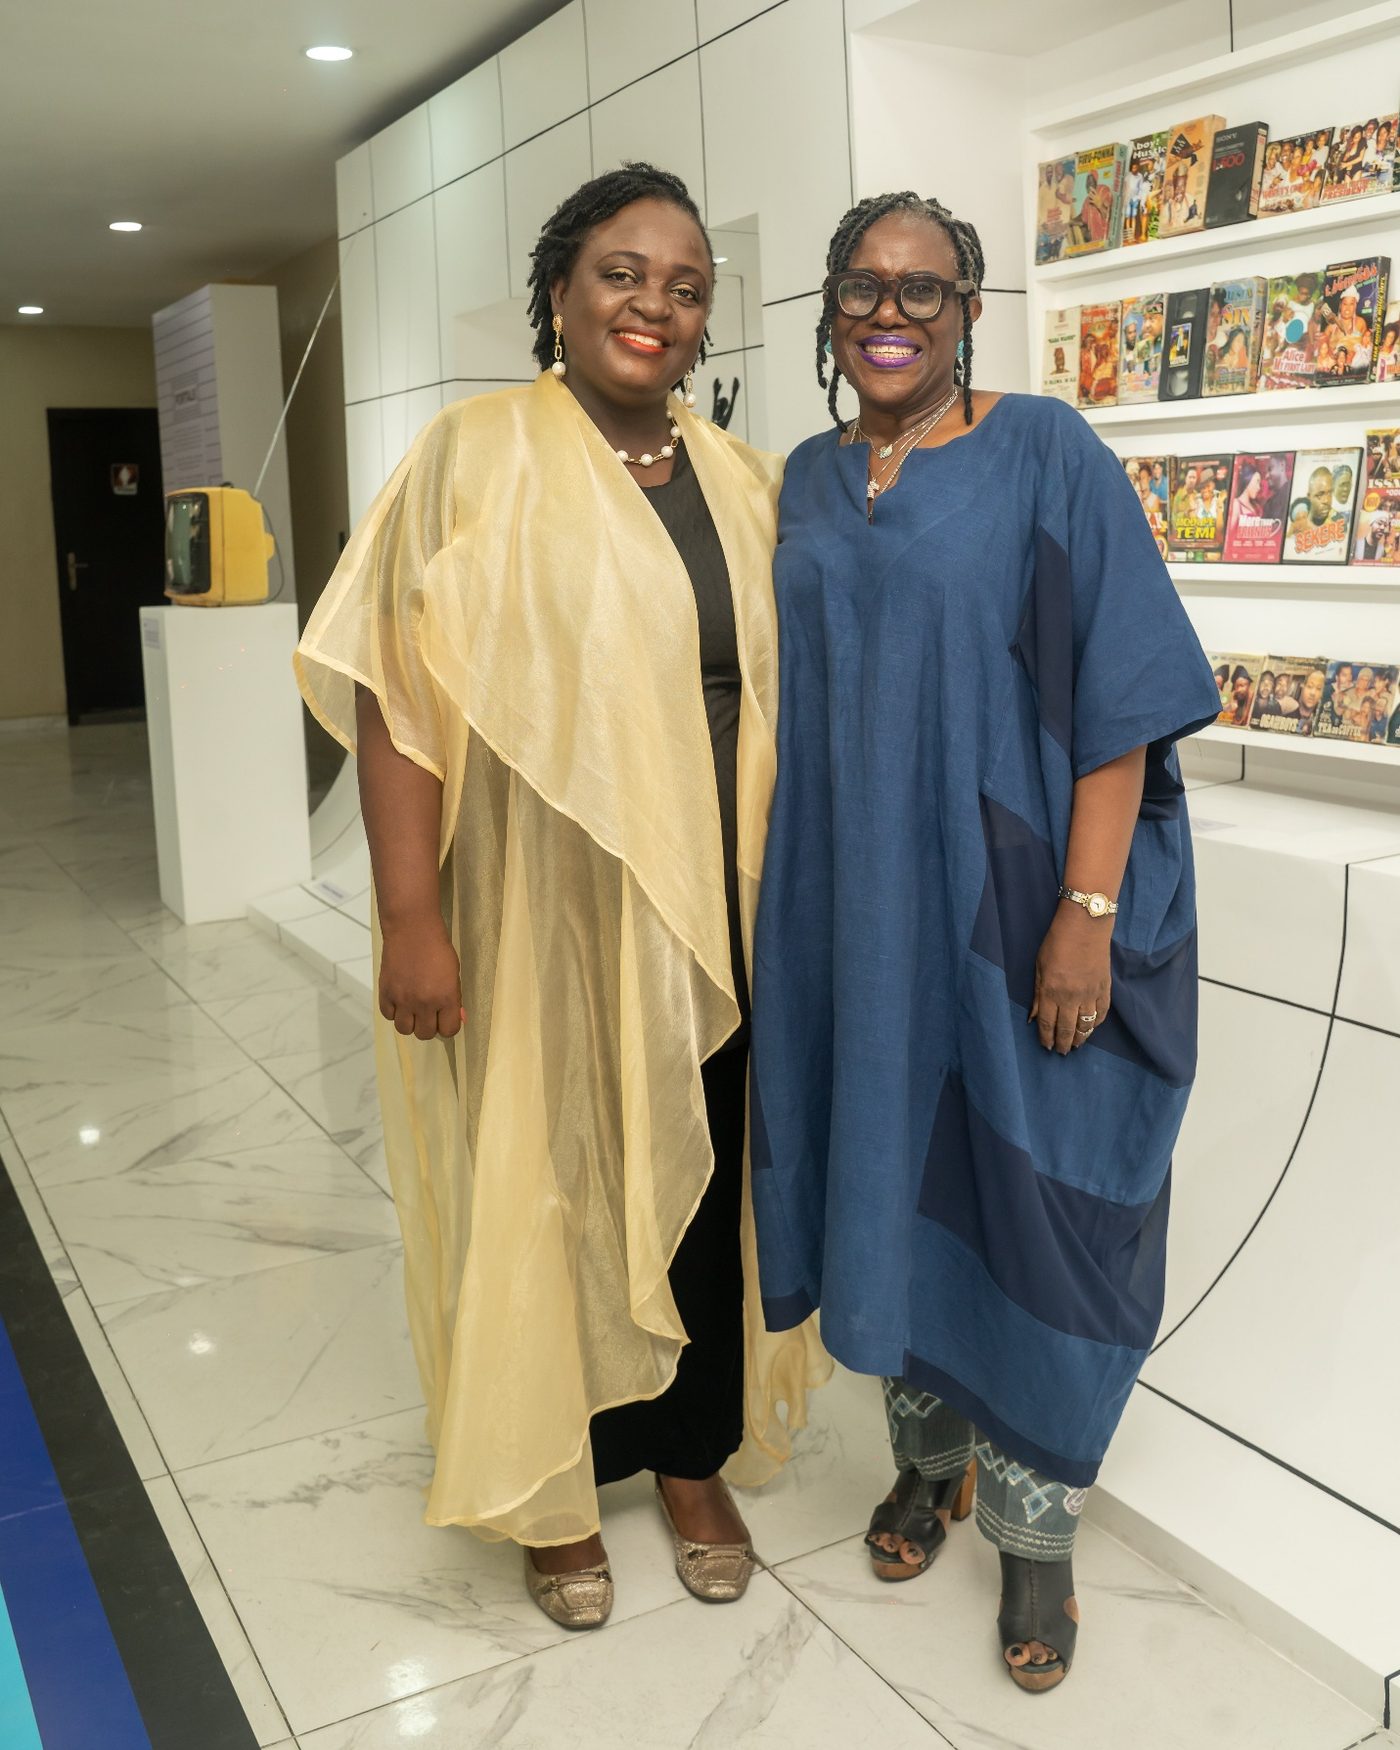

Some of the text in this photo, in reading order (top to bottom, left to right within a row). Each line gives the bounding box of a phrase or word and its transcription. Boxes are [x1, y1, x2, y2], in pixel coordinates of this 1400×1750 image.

[1216, 132, 1238, 143] SONY
[1283, 349, 1305, 362] Alice
[1176, 527, 1216, 539] TEMI
[1295, 519, 1345, 554] SEKERE
